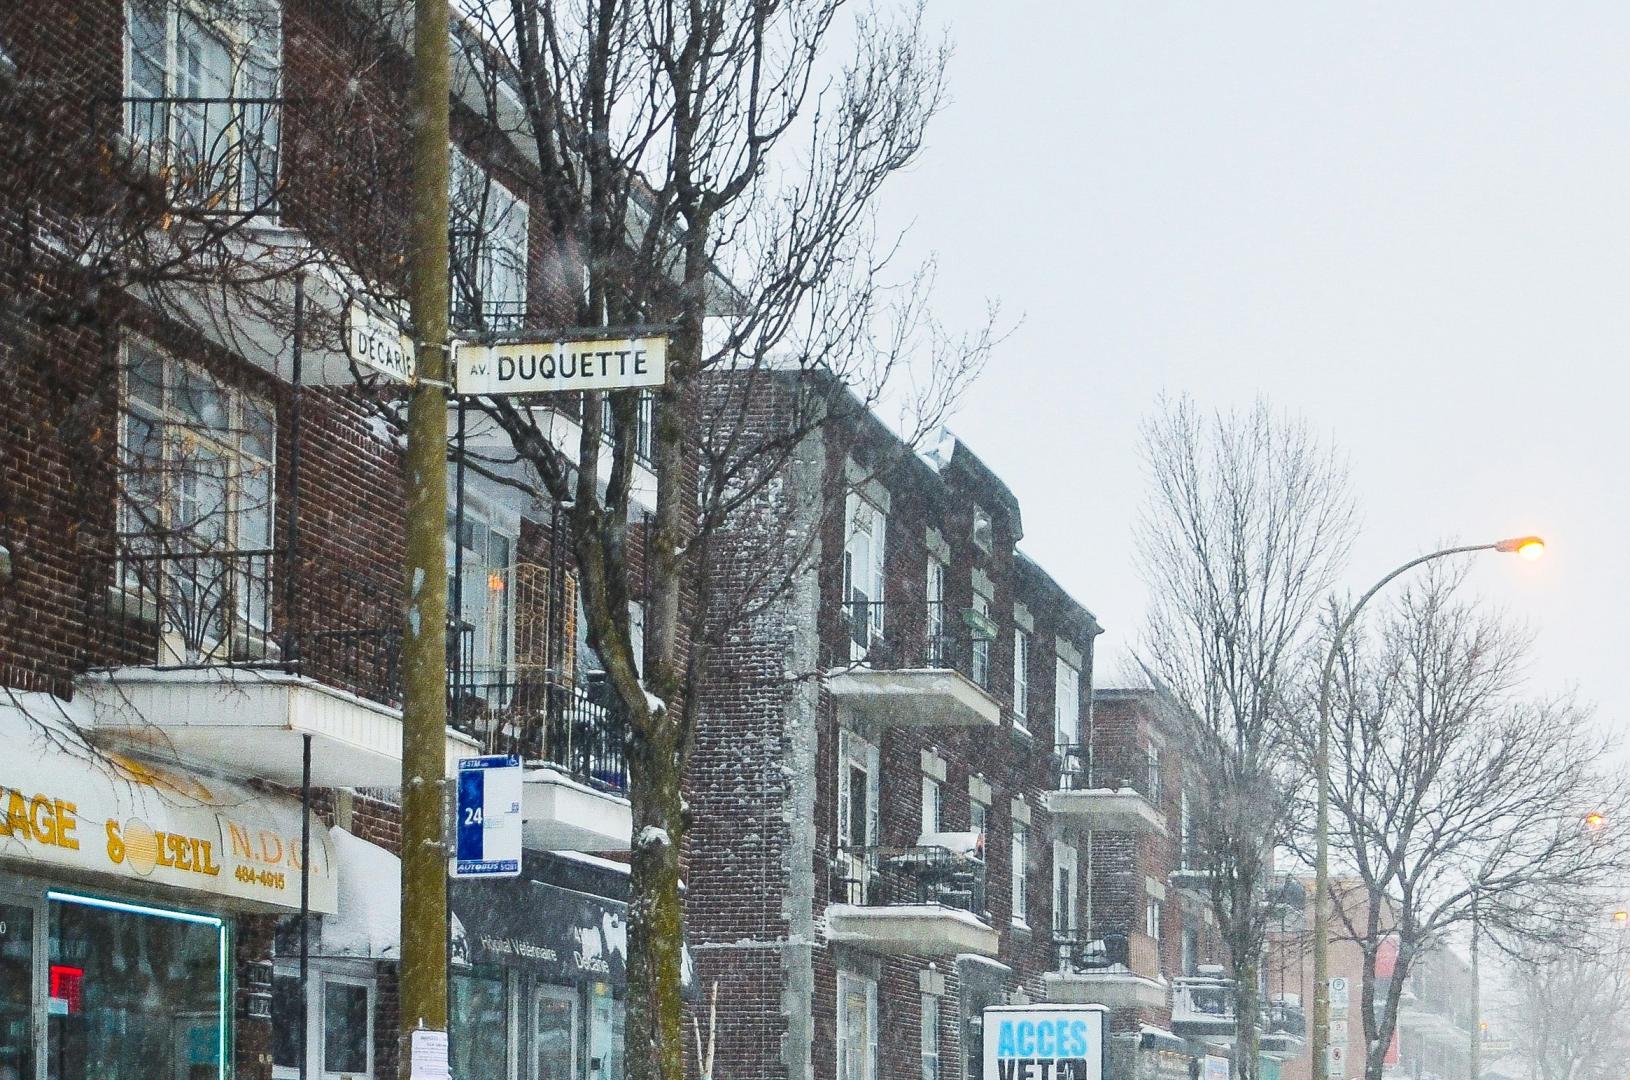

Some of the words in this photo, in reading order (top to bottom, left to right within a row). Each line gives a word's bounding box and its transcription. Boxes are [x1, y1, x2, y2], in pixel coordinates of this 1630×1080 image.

[470, 364, 490, 376] AV.
[498, 350, 648, 381] DUQUETTE
[464, 807, 482, 825] 24
[457, 862, 498, 871] AUTOBUS
[998, 1019, 1088, 1057] ACCES
